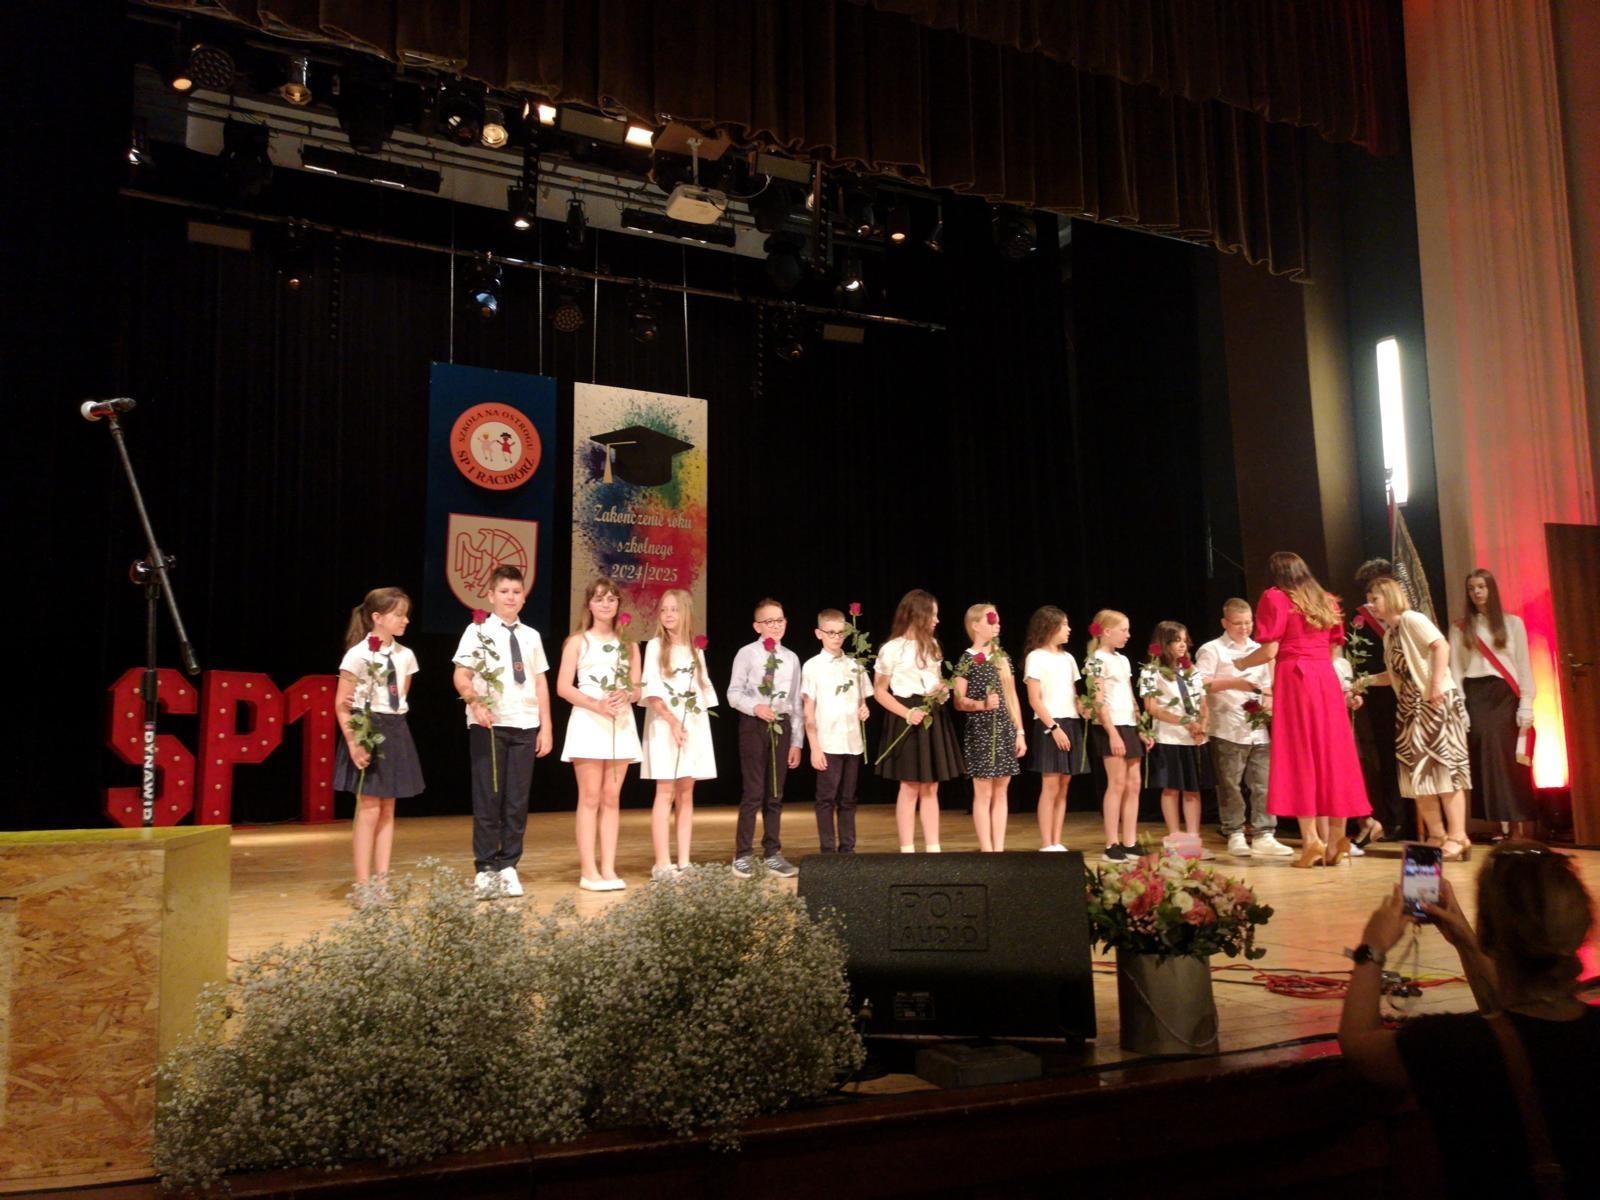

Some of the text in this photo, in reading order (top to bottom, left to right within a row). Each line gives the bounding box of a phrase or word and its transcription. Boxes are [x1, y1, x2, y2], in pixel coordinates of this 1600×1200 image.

[485, 409, 499, 417] NA
[502, 411, 534, 450] OSTROGU
[457, 450, 470, 465] SP
[667, 511, 692, 529] roku
[617, 536, 673, 560] szkolnego
[611, 562, 678, 589] 2024/2025
[106, 667, 338, 828] SP1
[901, 892, 978, 918] POL
[901, 926, 978, 943] AUDIO
